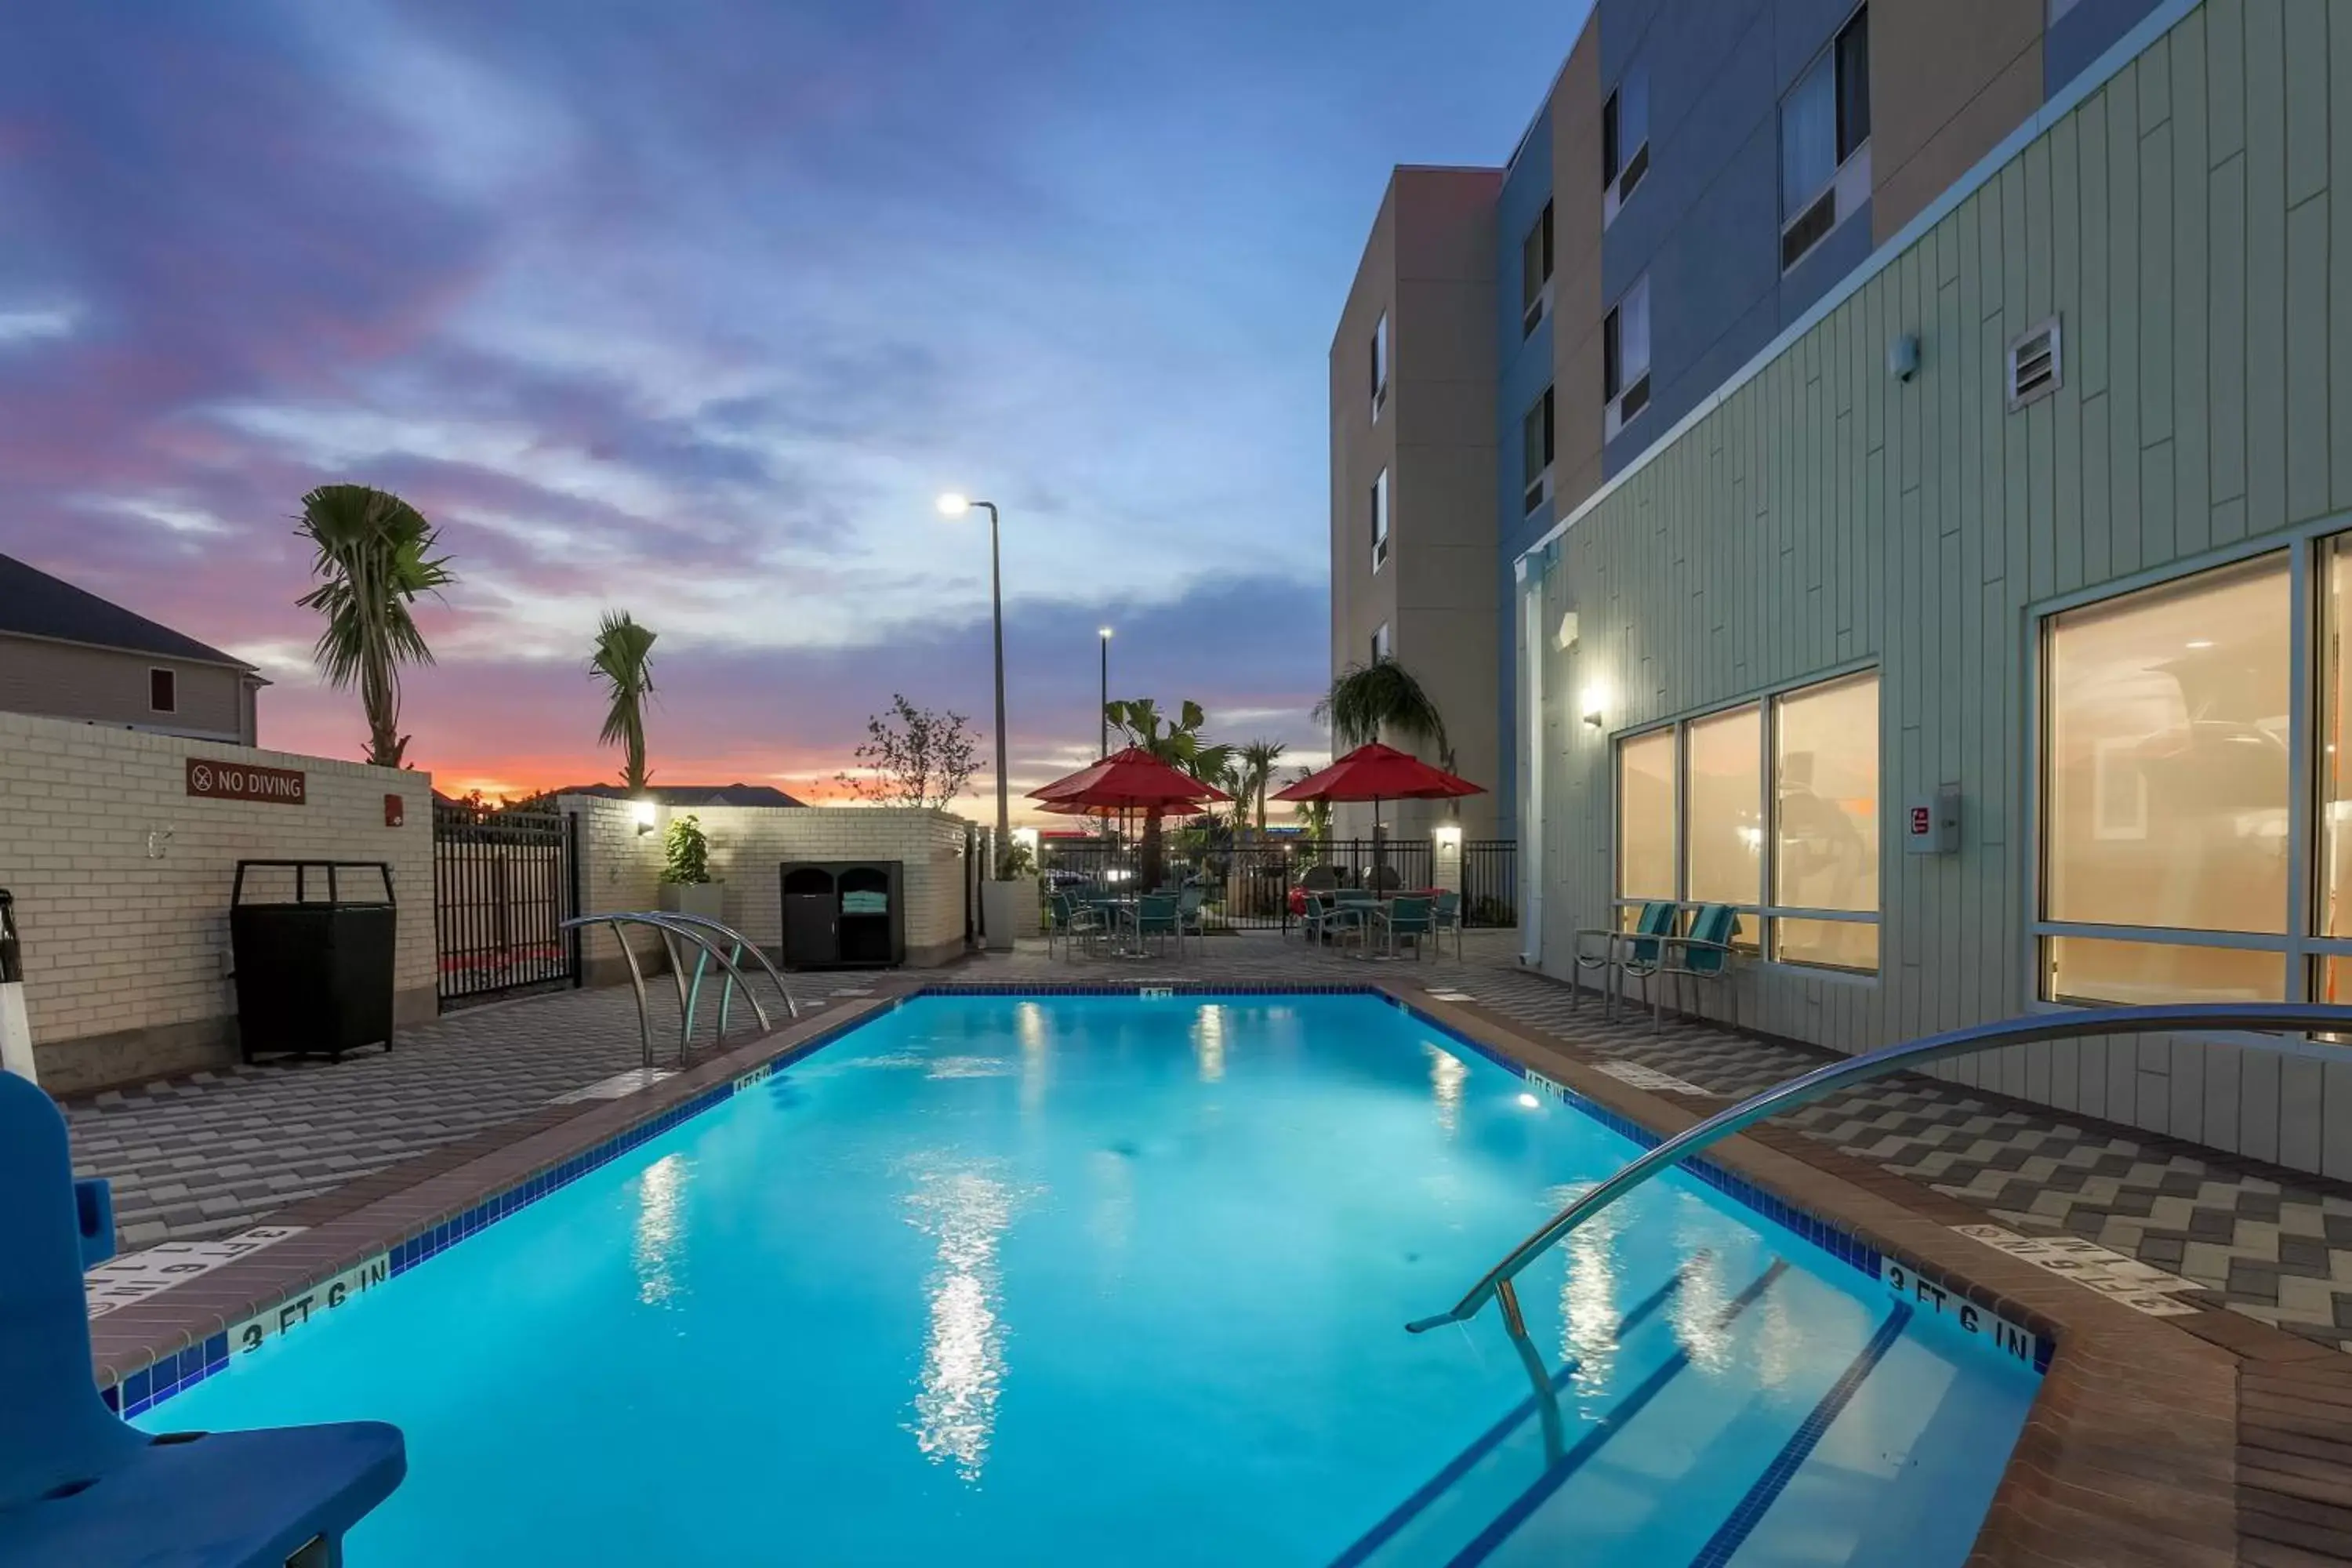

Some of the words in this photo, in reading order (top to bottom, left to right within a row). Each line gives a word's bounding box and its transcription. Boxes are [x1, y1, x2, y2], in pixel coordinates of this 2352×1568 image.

[219, 771, 244, 792] NO
[249, 774, 302, 797] DIVING
[160, 1263, 209, 1273] 6
[242, 1323, 263, 1354] 3
[280, 1296, 314, 1337] FT
[361, 1259, 387, 1294] IN
[1889, 1266, 1905, 1291] 3
[1916, 1281, 1947, 1314] FT
[1996, 1320, 2027, 1361] IN
